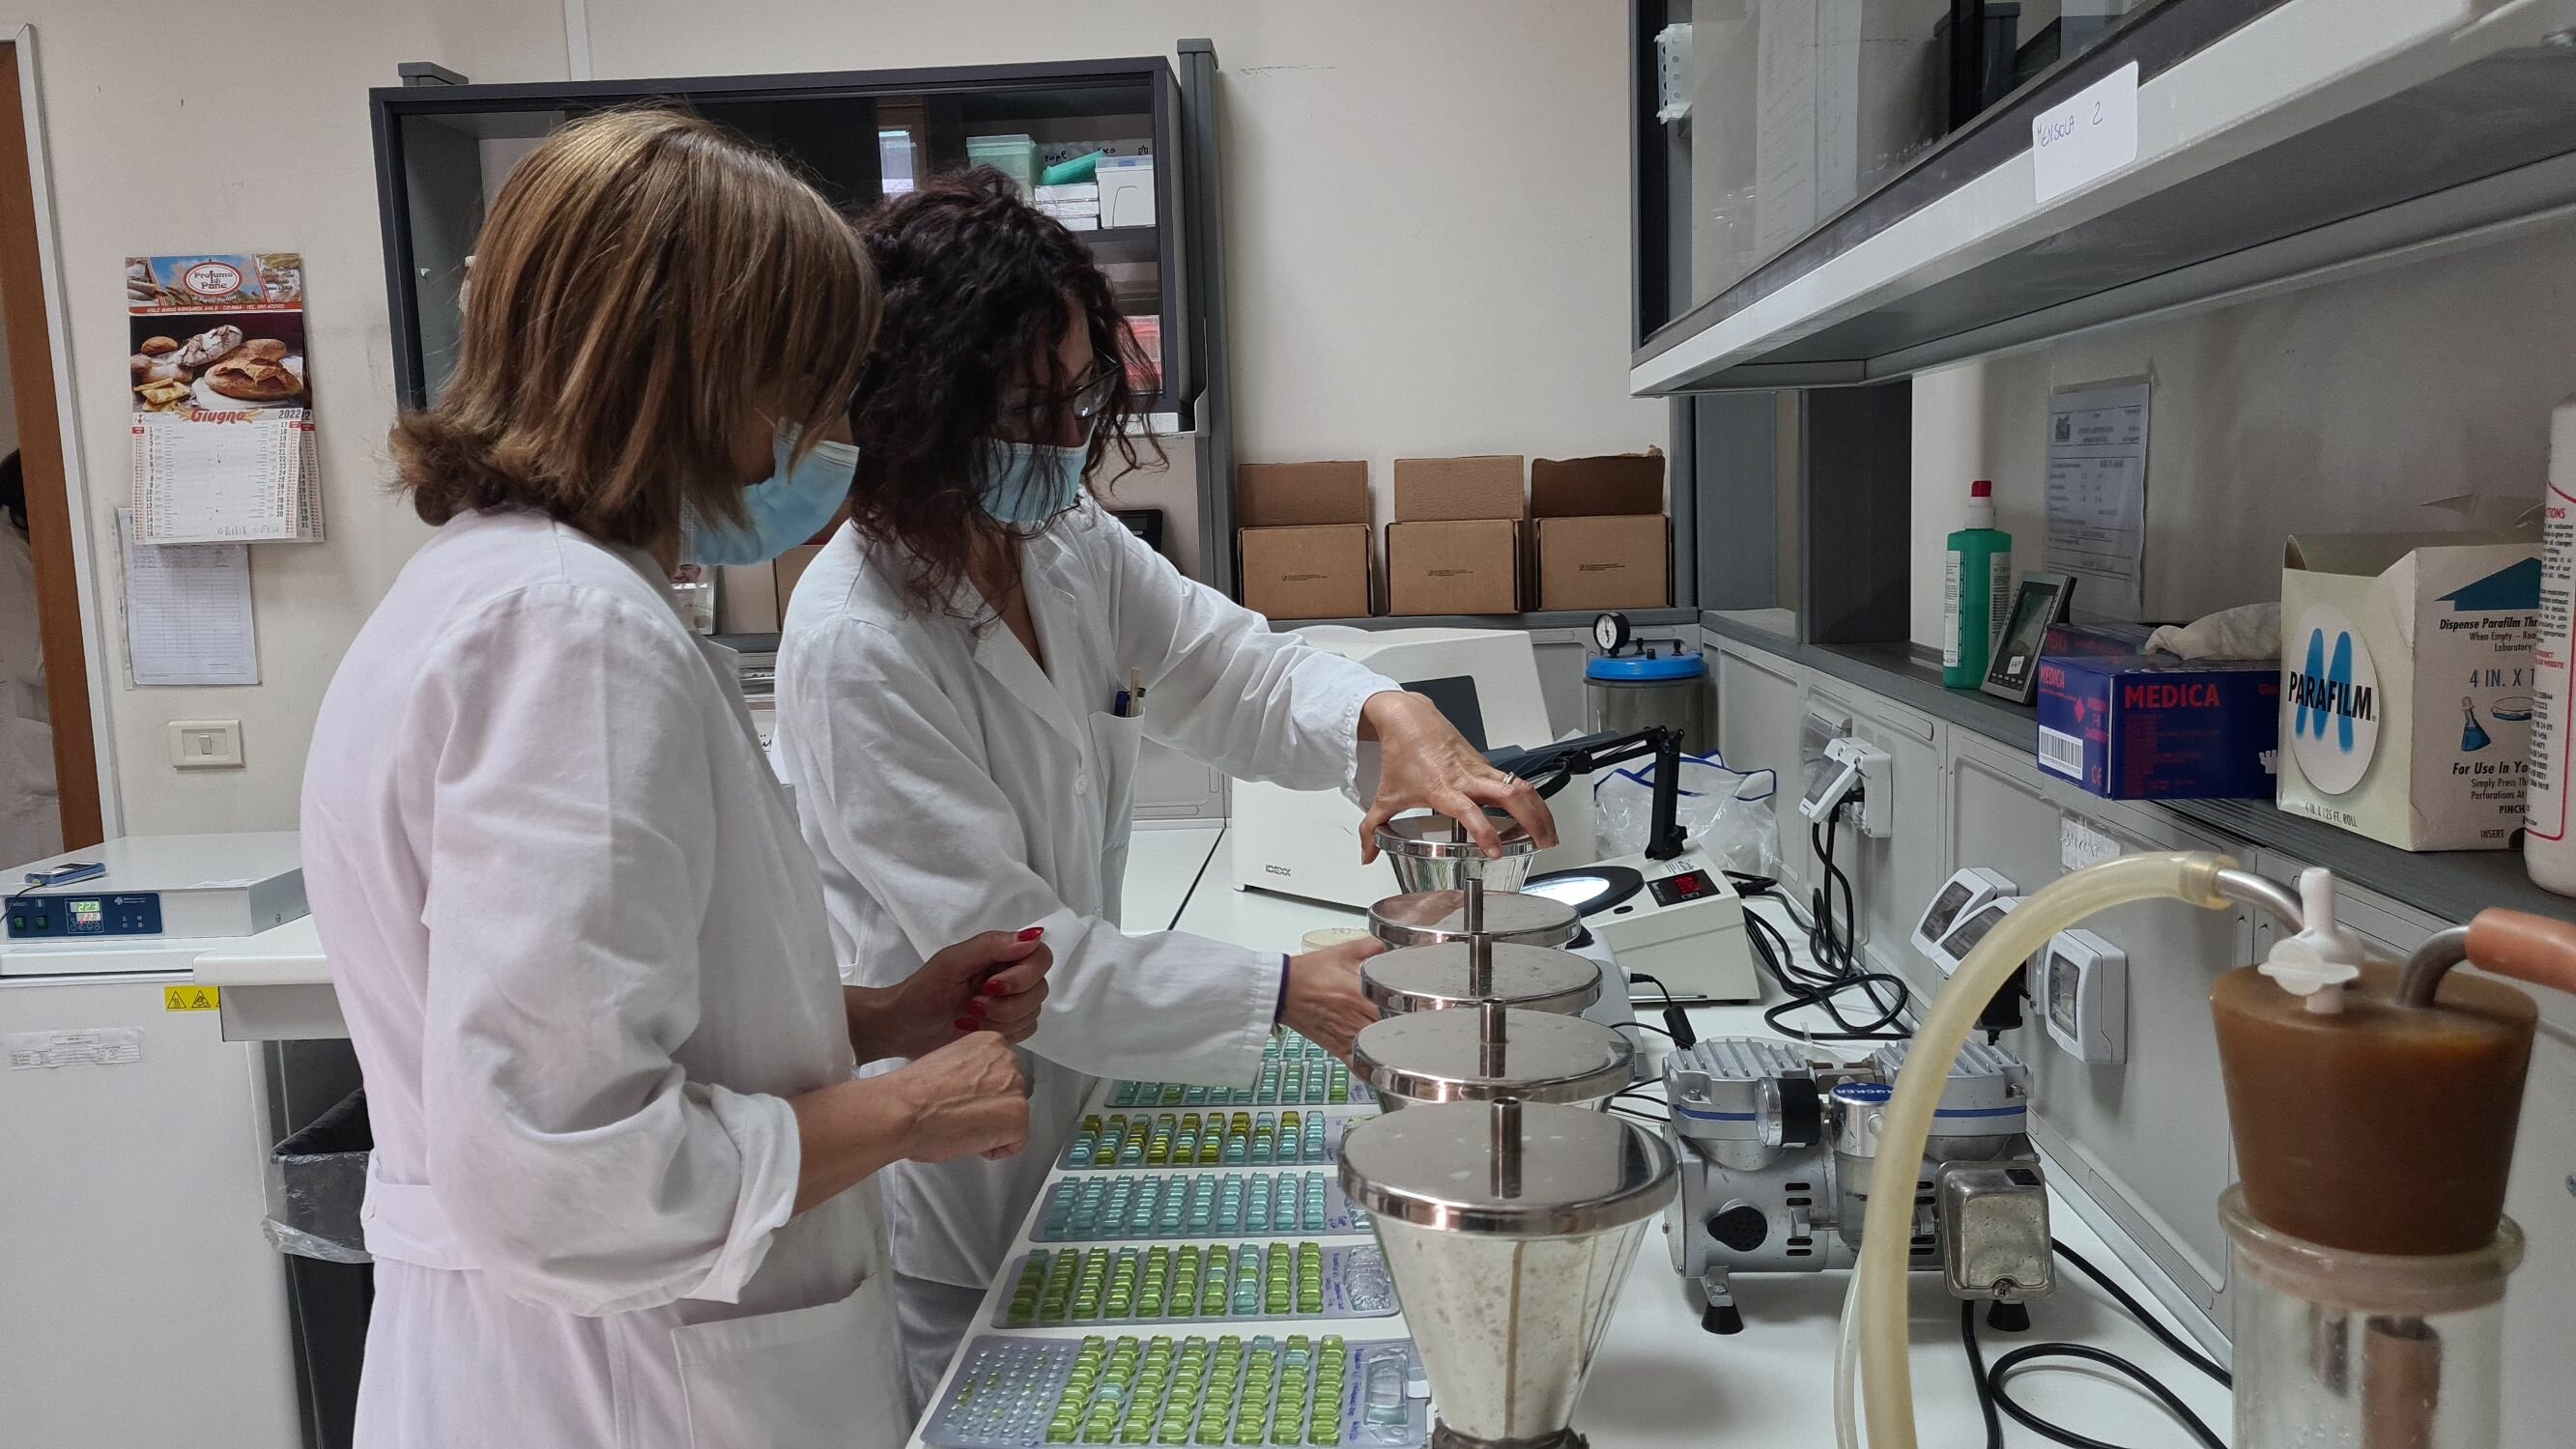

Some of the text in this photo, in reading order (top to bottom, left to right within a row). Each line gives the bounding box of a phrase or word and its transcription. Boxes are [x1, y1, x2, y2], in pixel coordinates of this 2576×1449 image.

[2092, 100, 2104, 126] 2
[194, 270, 233, 283] Profumo
[190, 407, 301, 424] Giugno 2022
[2542, 507, 2566, 519] TIONS
[2440, 619, 2479, 632] Dispense
[2482, 617, 2520, 629] Parafilm
[2491, 631, 2512, 641] Empty
[2495, 642, 2532, 653] Laboratory
[2040, 665, 2065, 689] MEDICA
[2470, 669, 2478, 687] 4
[2485, 668, 2505, 687] IN.
[2512, 668, 2522, 687] X
[2125, 684, 2220, 709] MEDICA
[2452, 762, 2470, 775] For
[2474, 762, 2495, 774] Use
[2499, 761, 2509, 774] In
[2471, 778, 2495, 789] Simply
[2498, 779, 2516, 787] Press
[2471, 790, 2515, 800] Perforations
[2499, 804, 2525, 814] PINCH
[2322, 807, 2333, 820] 125
[2333, 810, 2342, 823] FT.
[2343, 813, 2358, 828] ROLL
[2480, 829, 2504, 838] INSERT
